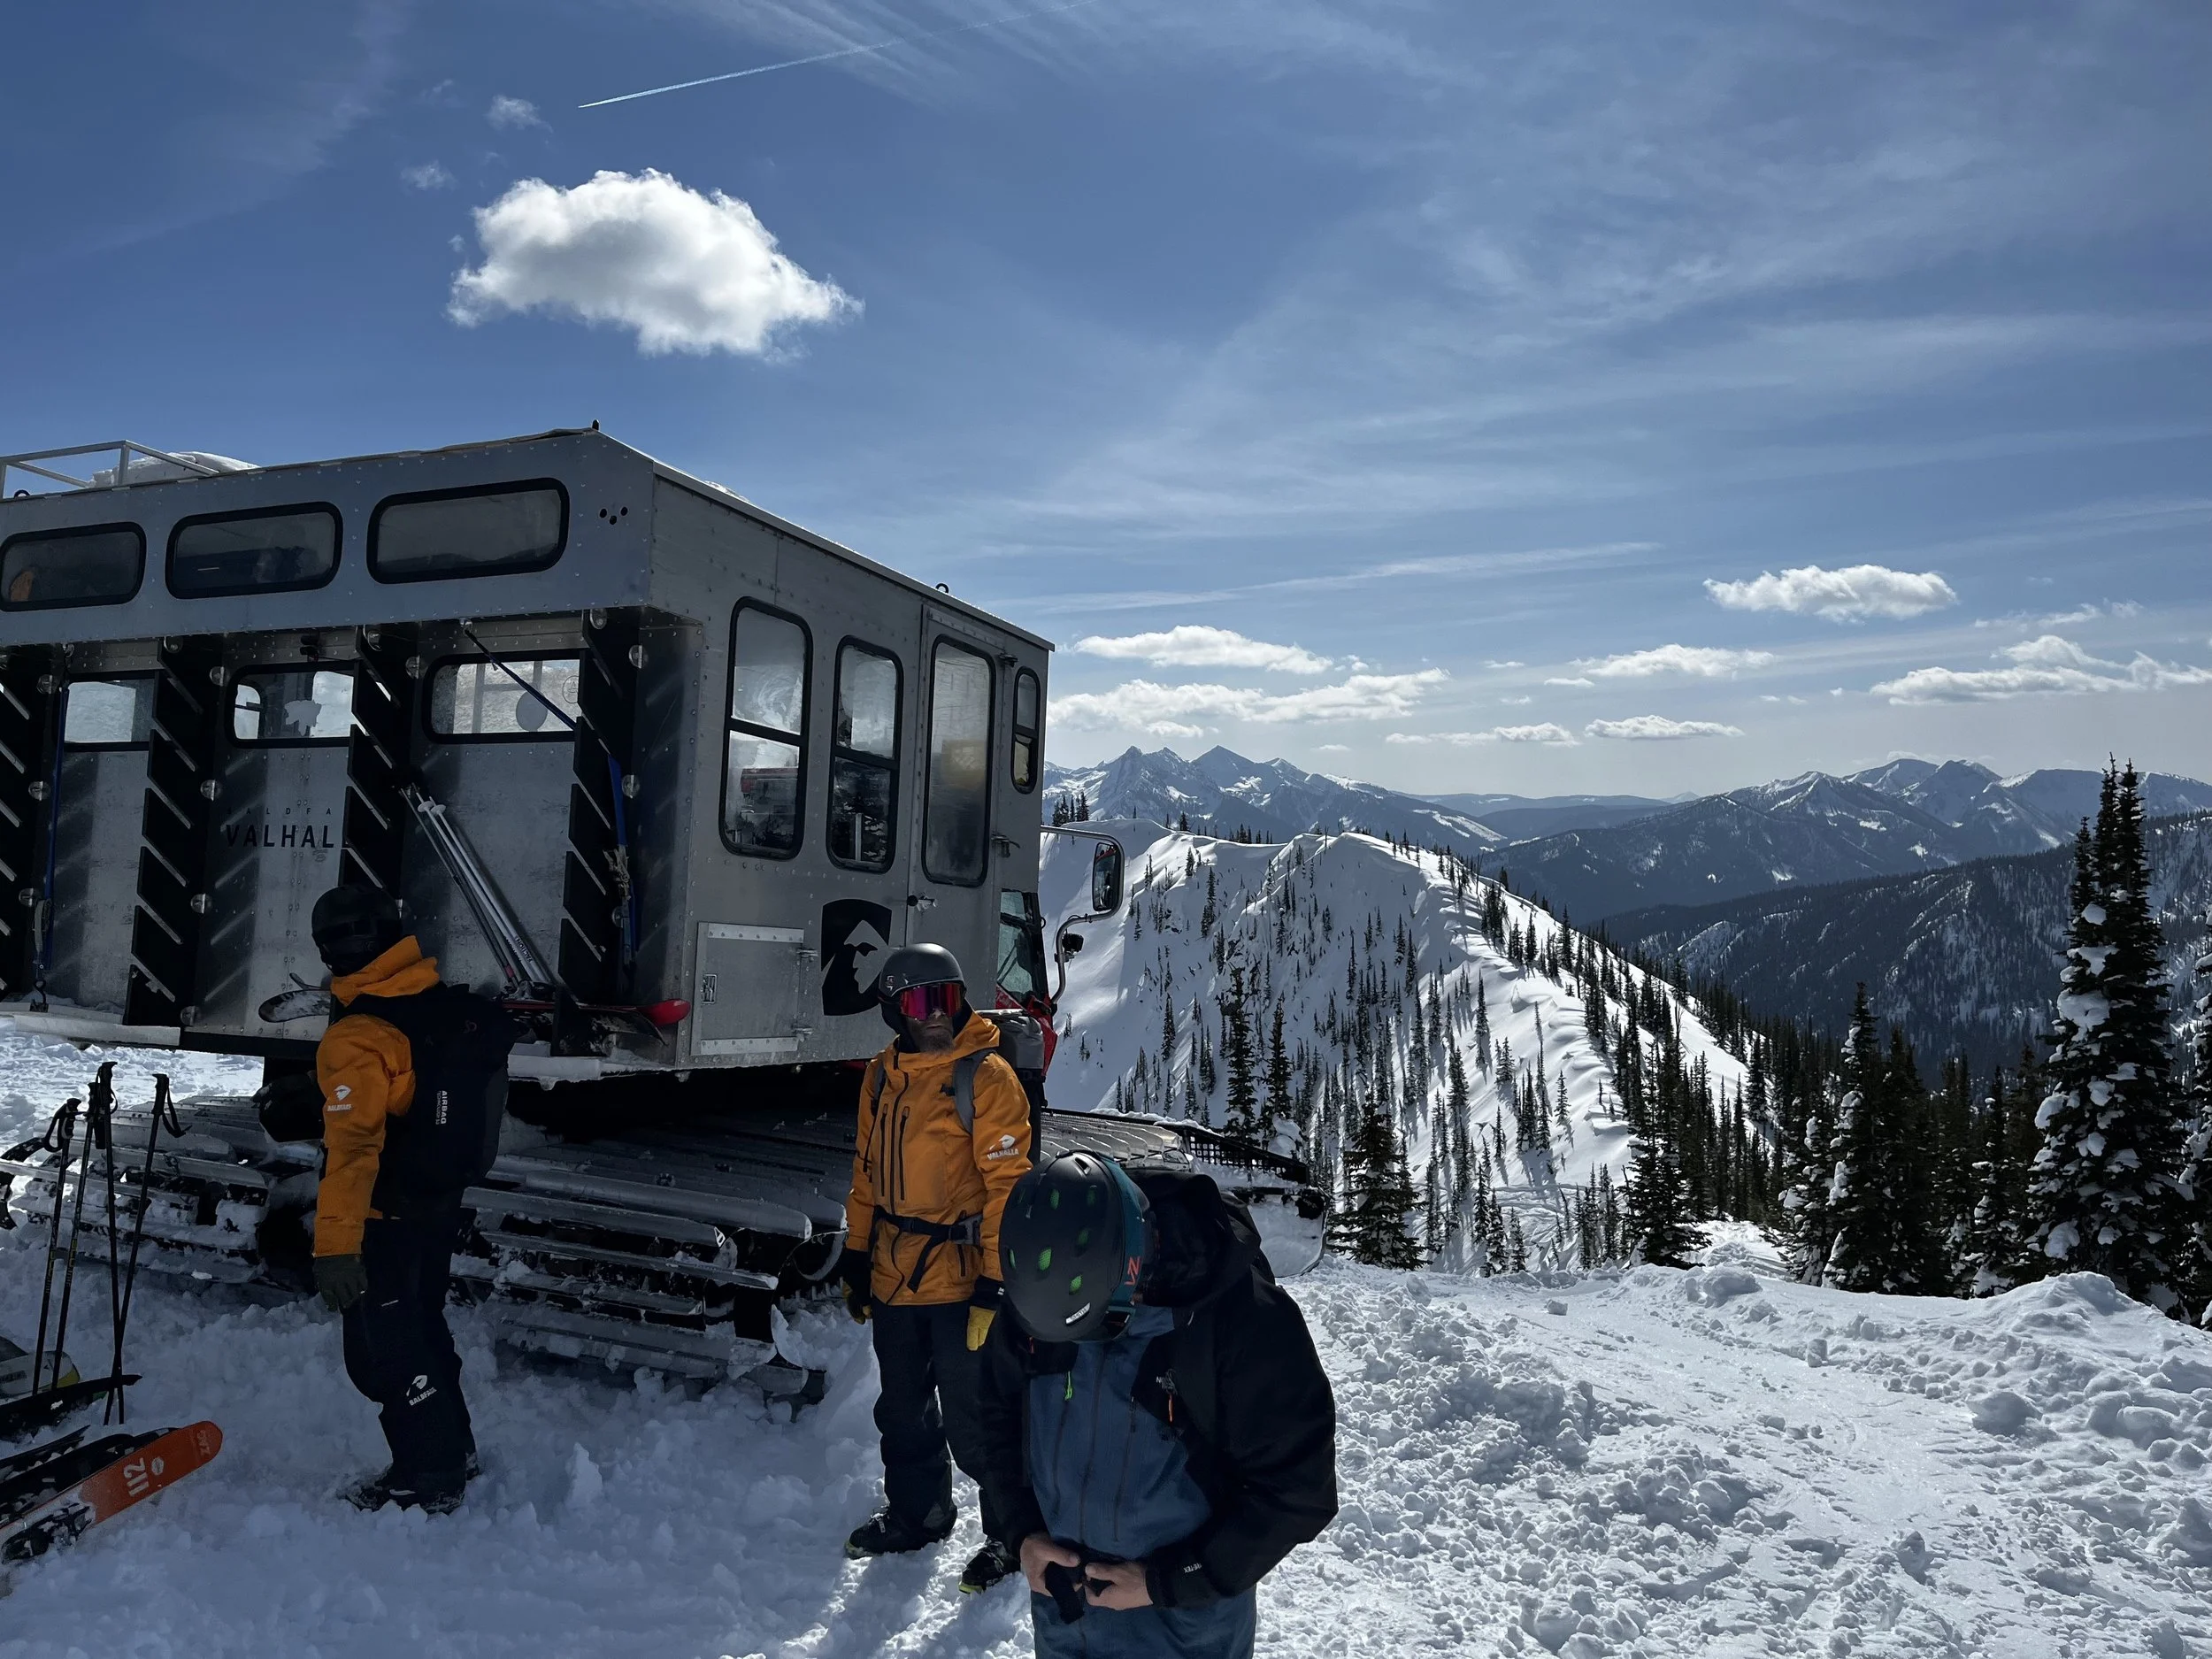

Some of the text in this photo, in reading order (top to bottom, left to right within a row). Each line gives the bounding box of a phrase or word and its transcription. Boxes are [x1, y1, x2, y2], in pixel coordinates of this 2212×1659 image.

[226, 824, 334, 848] VALHAL
[987, 1148, 1020, 1161] VALHALLA
[124, 1457, 150, 1497] 112
